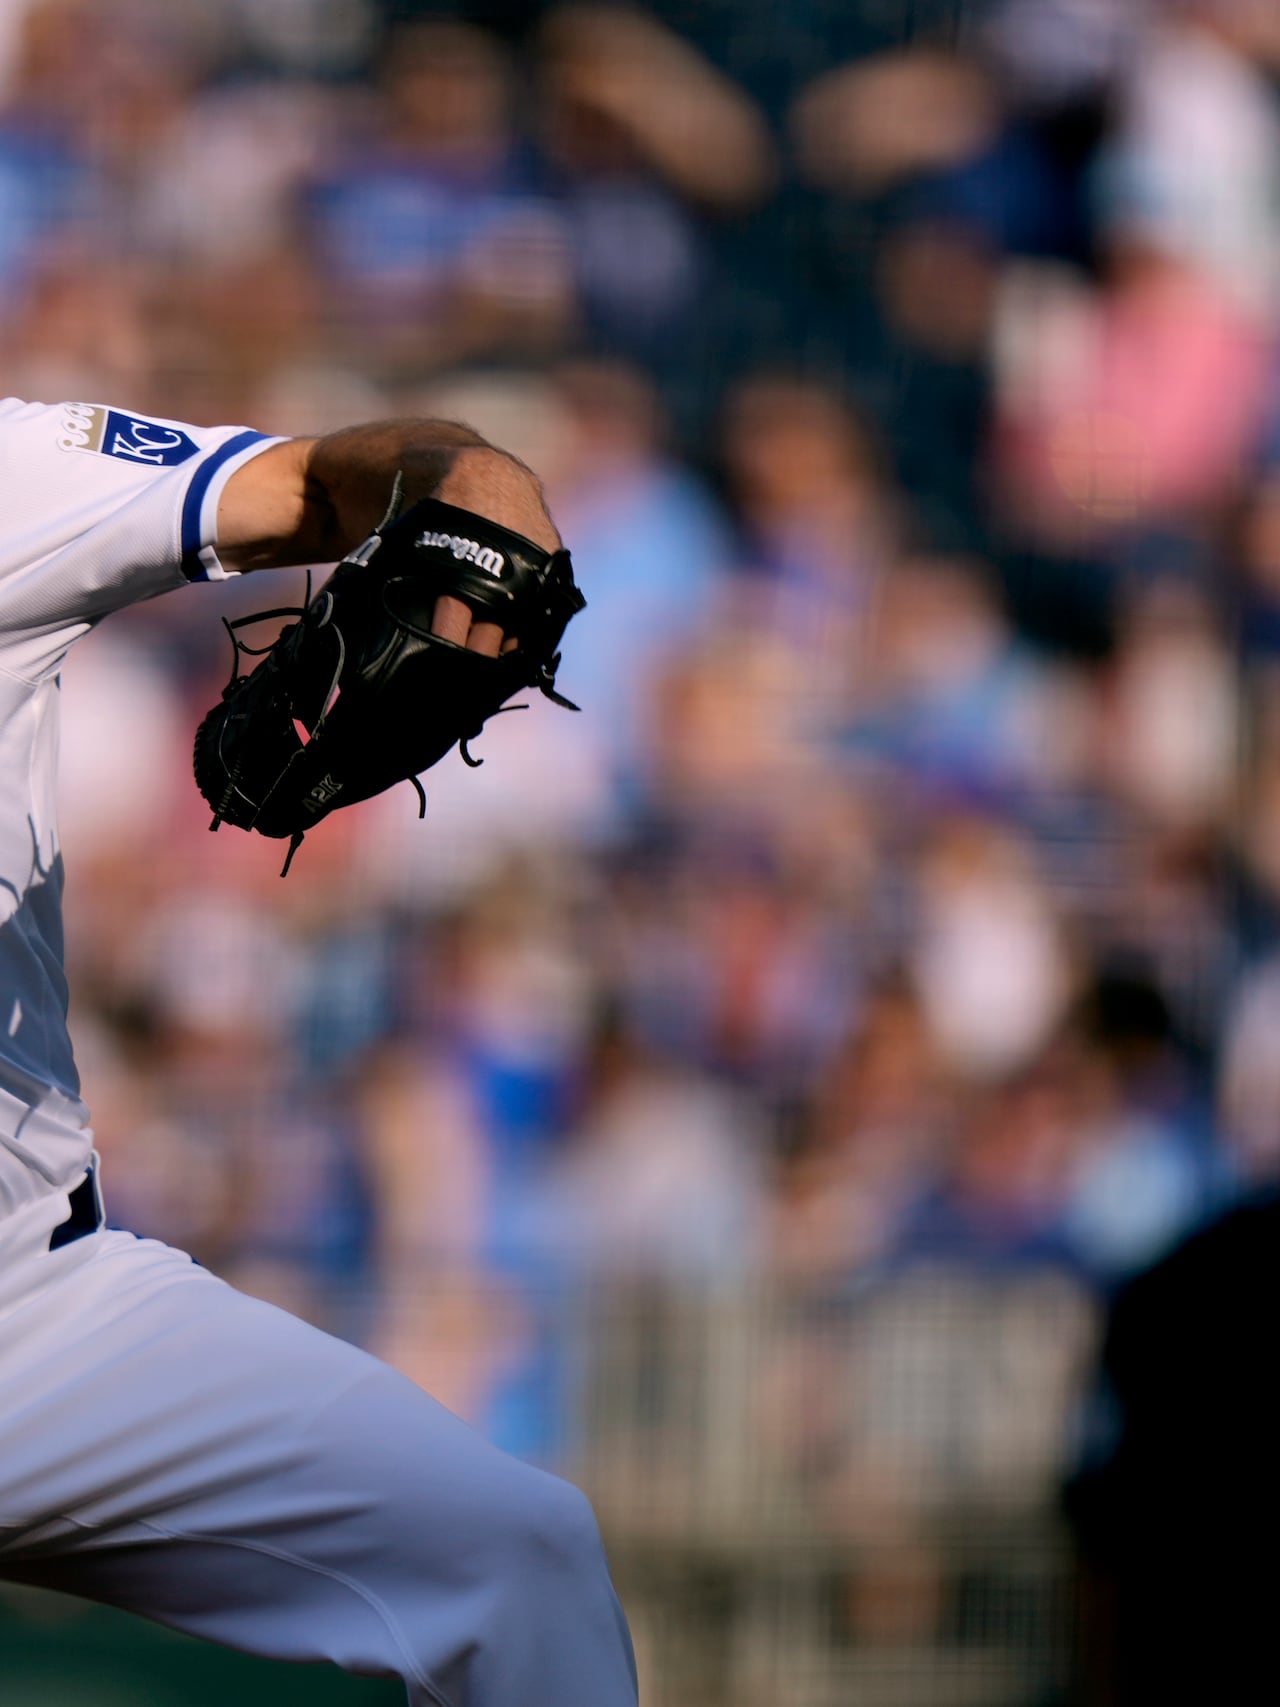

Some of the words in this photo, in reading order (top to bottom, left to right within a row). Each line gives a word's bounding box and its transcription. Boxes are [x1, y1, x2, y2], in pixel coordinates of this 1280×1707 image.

[112, 421, 182, 465] KC
[421, 531, 505, 578] Wilson
[303, 772, 345, 814] A2K
